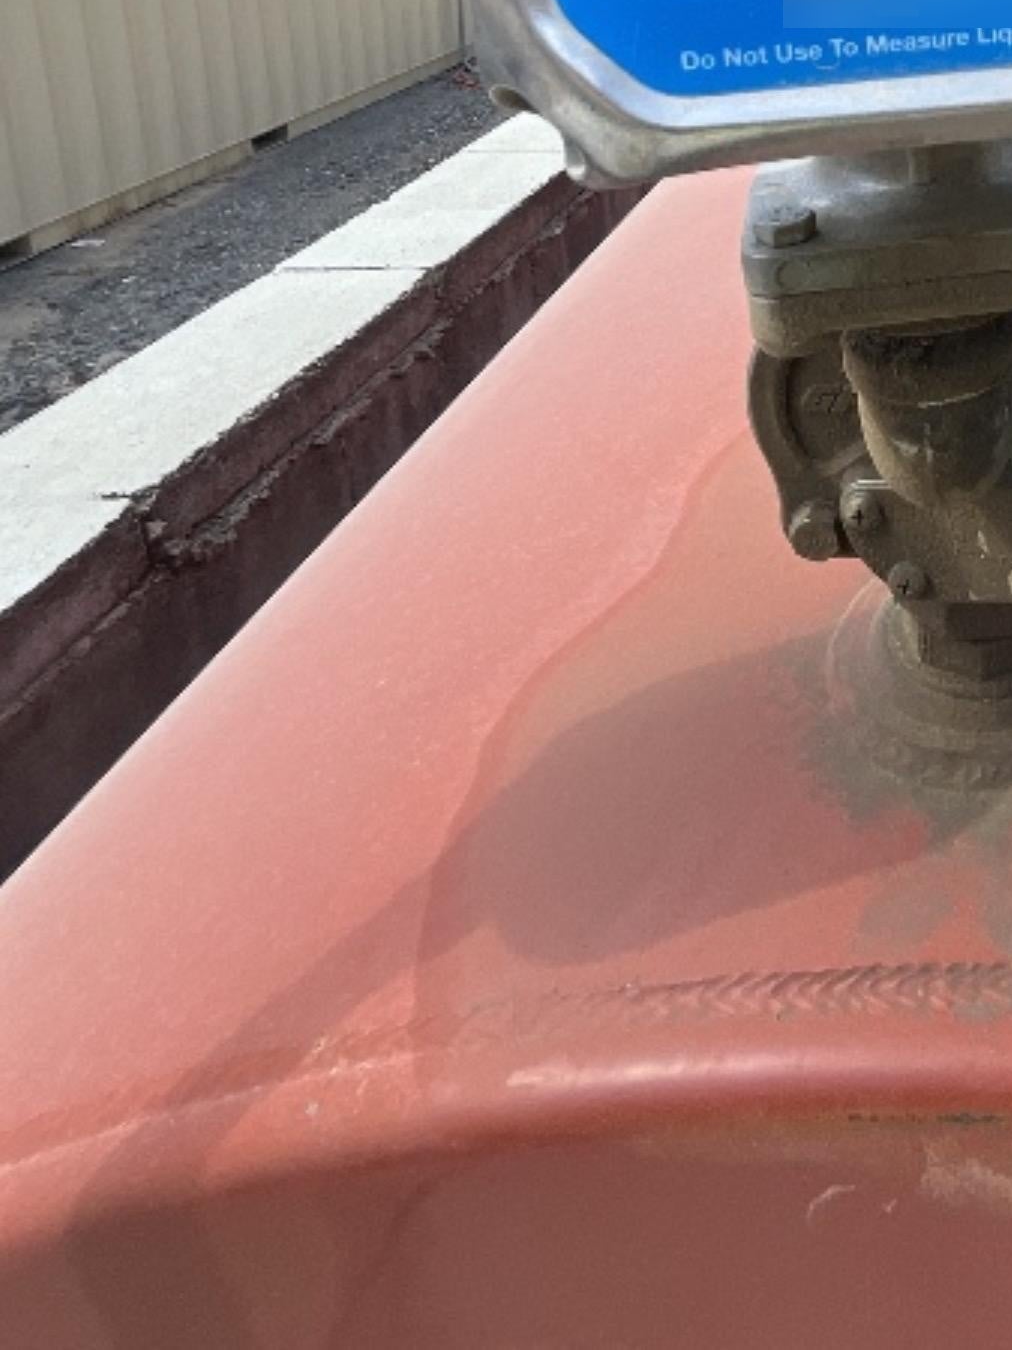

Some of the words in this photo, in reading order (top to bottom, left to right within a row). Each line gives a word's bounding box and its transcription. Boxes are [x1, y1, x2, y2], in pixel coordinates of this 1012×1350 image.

[680, 50, 716, 71] Do
[722, 47, 770, 67] Not
[775, 42, 823, 63] Use
[828, 37, 859, 58] To
[866, 30, 970, 55] Measure
